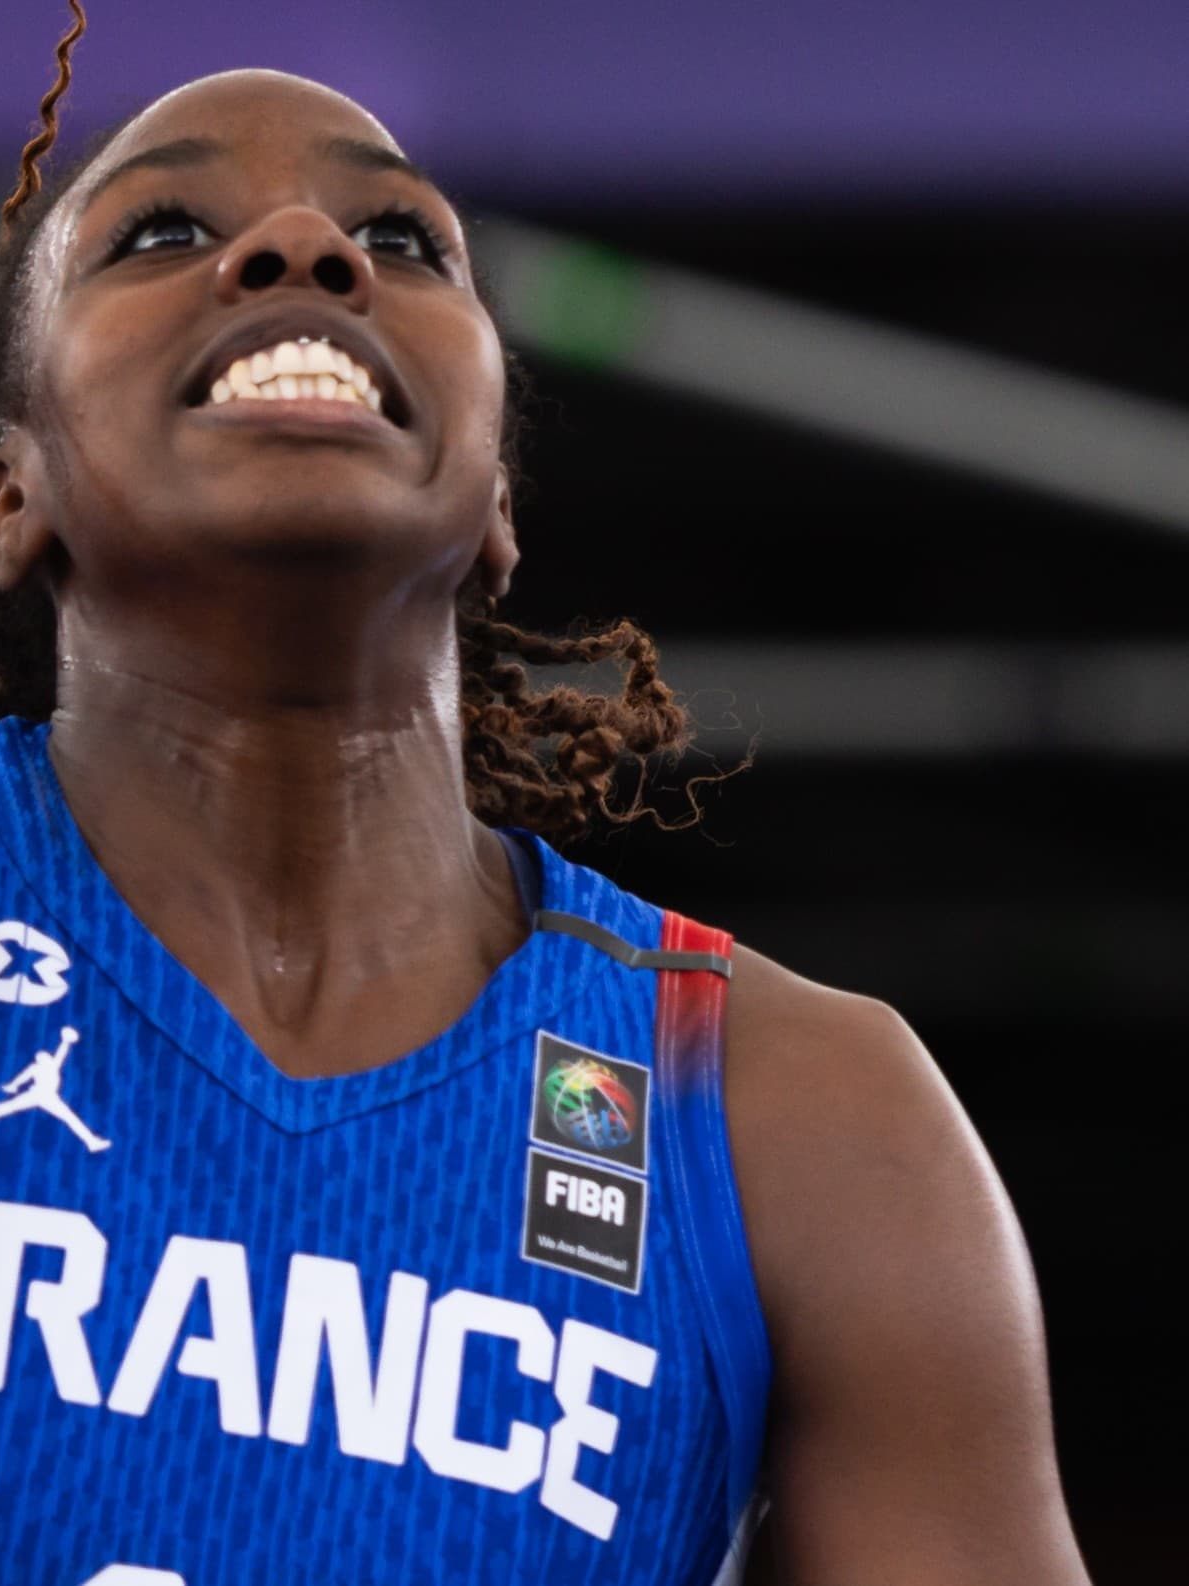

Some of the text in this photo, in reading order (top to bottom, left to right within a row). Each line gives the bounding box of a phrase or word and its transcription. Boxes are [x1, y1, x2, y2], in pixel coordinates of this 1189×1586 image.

[544, 1169, 626, 1227] FIBA
[537, 1234, 556, 1250] We
[557, 1239, 576, 1255] Are
